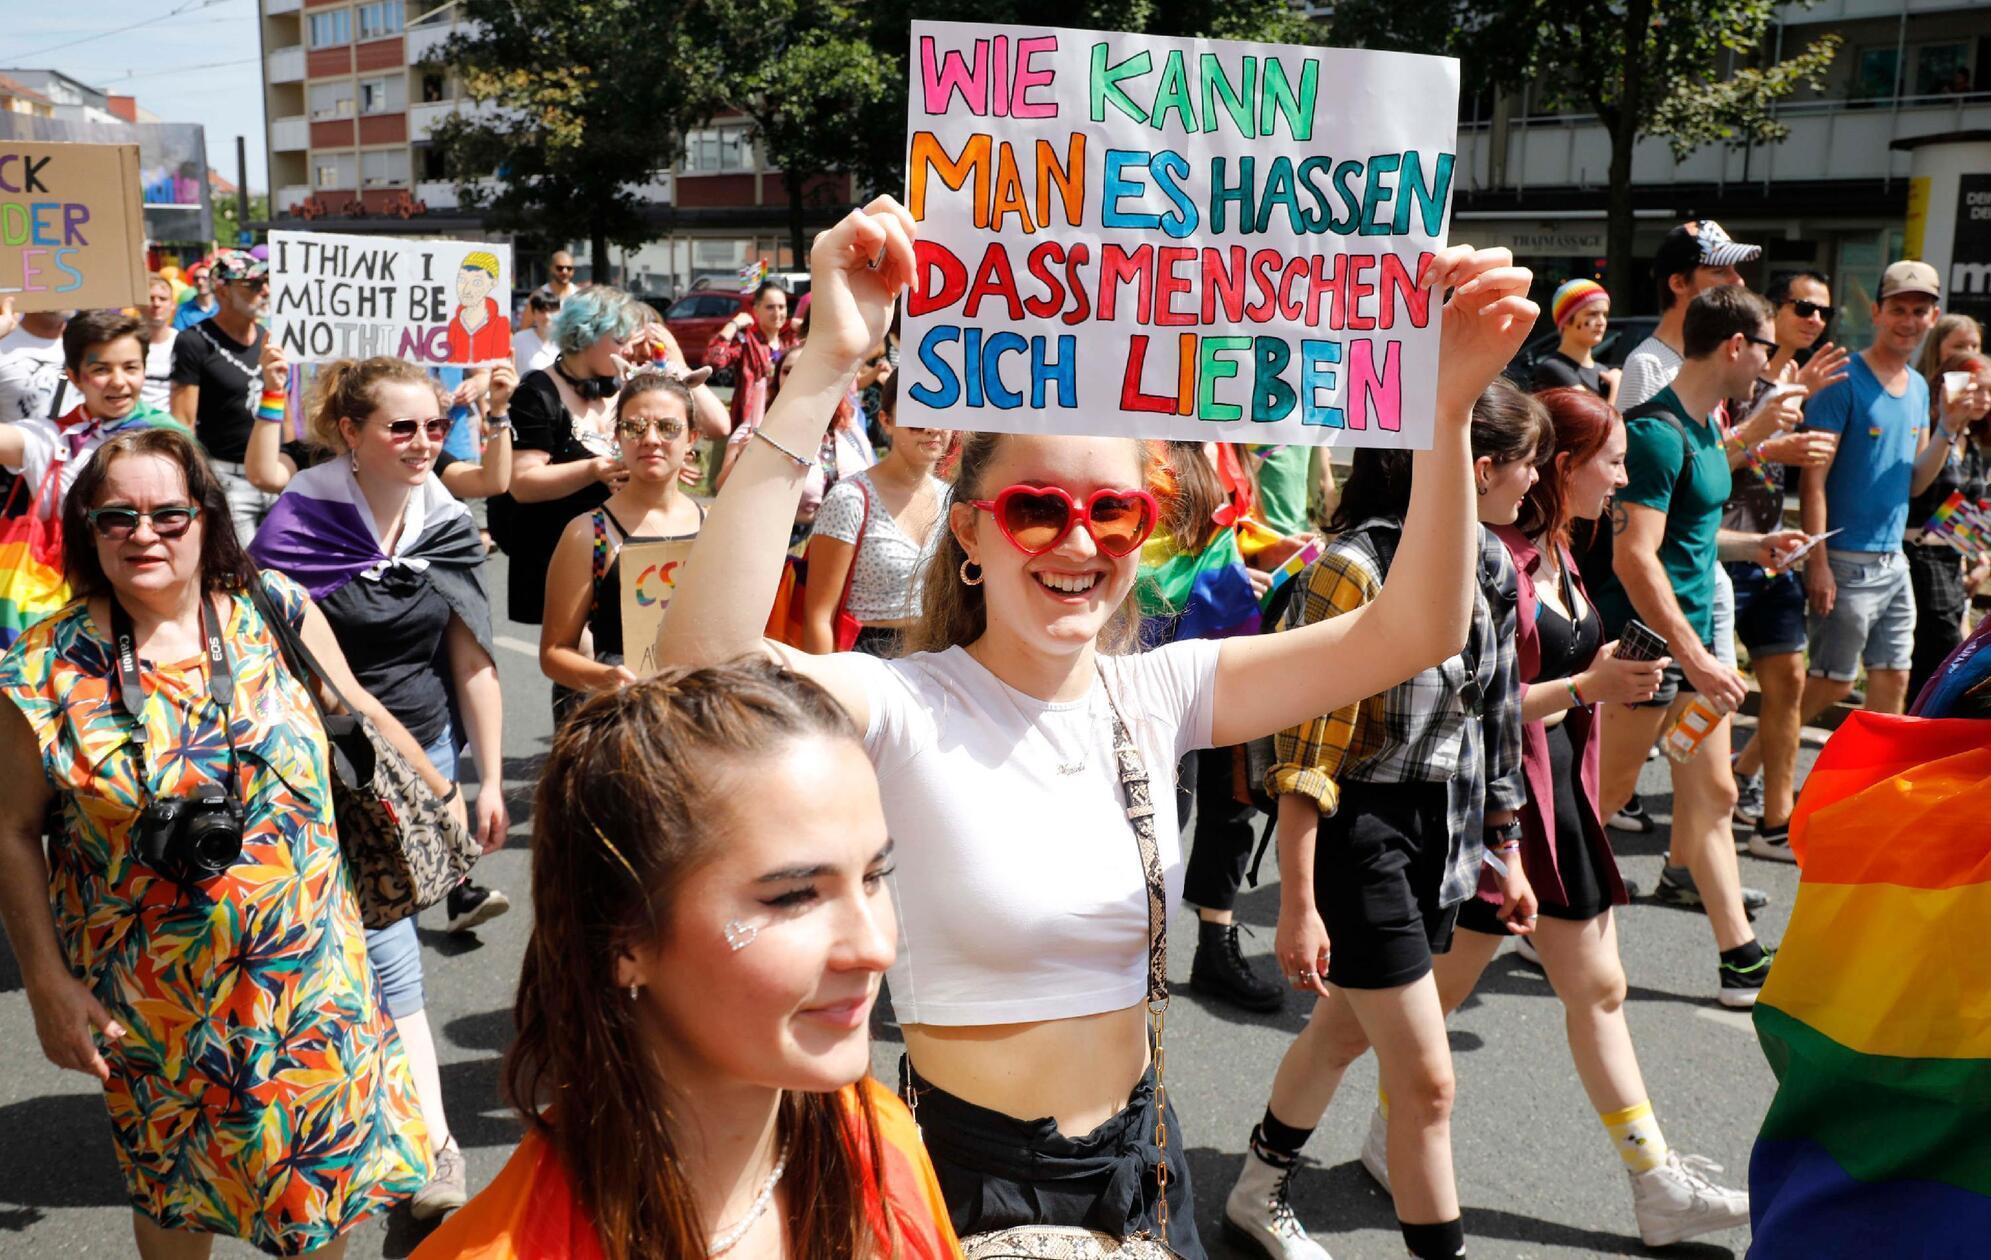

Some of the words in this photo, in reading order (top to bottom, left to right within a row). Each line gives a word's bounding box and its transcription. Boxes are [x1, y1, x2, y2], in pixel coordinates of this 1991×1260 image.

[920, 35, 1059, 119] WIE
[1090, 42, 1319, 141] KANN
[0, 154, 52, 193] CK
[909, 131, 1087, 234] MAN
[1102, 149, 1199, 238] ES
[1210, 152, 1456, 236] HASSEN
[2, 202, 90, 246] DER
[276, 240, 288, 273] I
[297, 241, 398, 281] THINK
[421, 253, 433, 281] I
[276, 279, 396, 319] MIGHT
[409, 285, 447, 322] BE
[907, 239, 1090, 325] DASS
[1096, 244, 1435, 330] MENSCHEN
[281, 319, 452, 362] NOTHING
[909, 325, 1078, 409] SICH
[1119, 333, 1402, 432] LIEBEN
[119, 634, 134, 673] Canon
[209, 636, 223, 662] EOS
